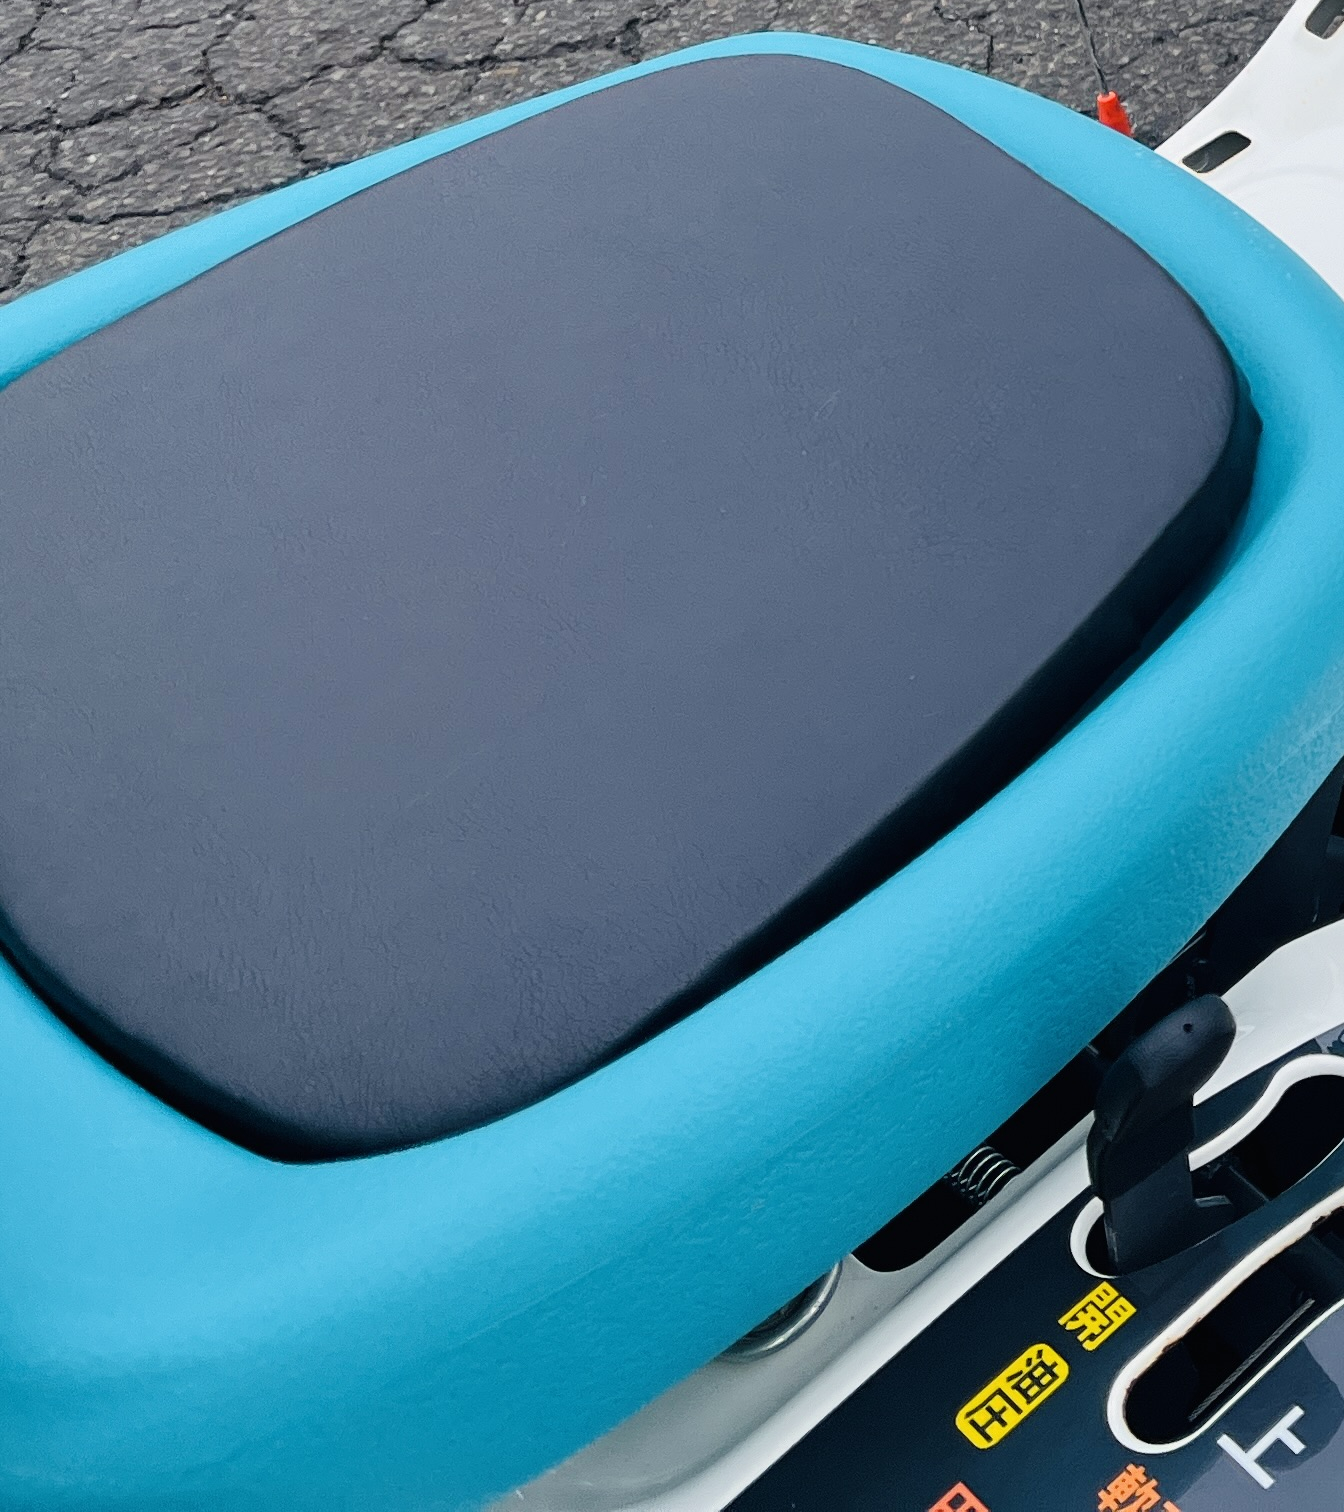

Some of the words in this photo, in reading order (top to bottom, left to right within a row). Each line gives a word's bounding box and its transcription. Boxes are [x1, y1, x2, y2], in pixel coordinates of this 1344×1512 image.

[1058, 1281, 1137, 1352] 開
[964, 1348, 1059, 1443] 油圧
[1216, 1404, 1307, 1490] 上
[1097, 1463, 1182, 1511] 軟
